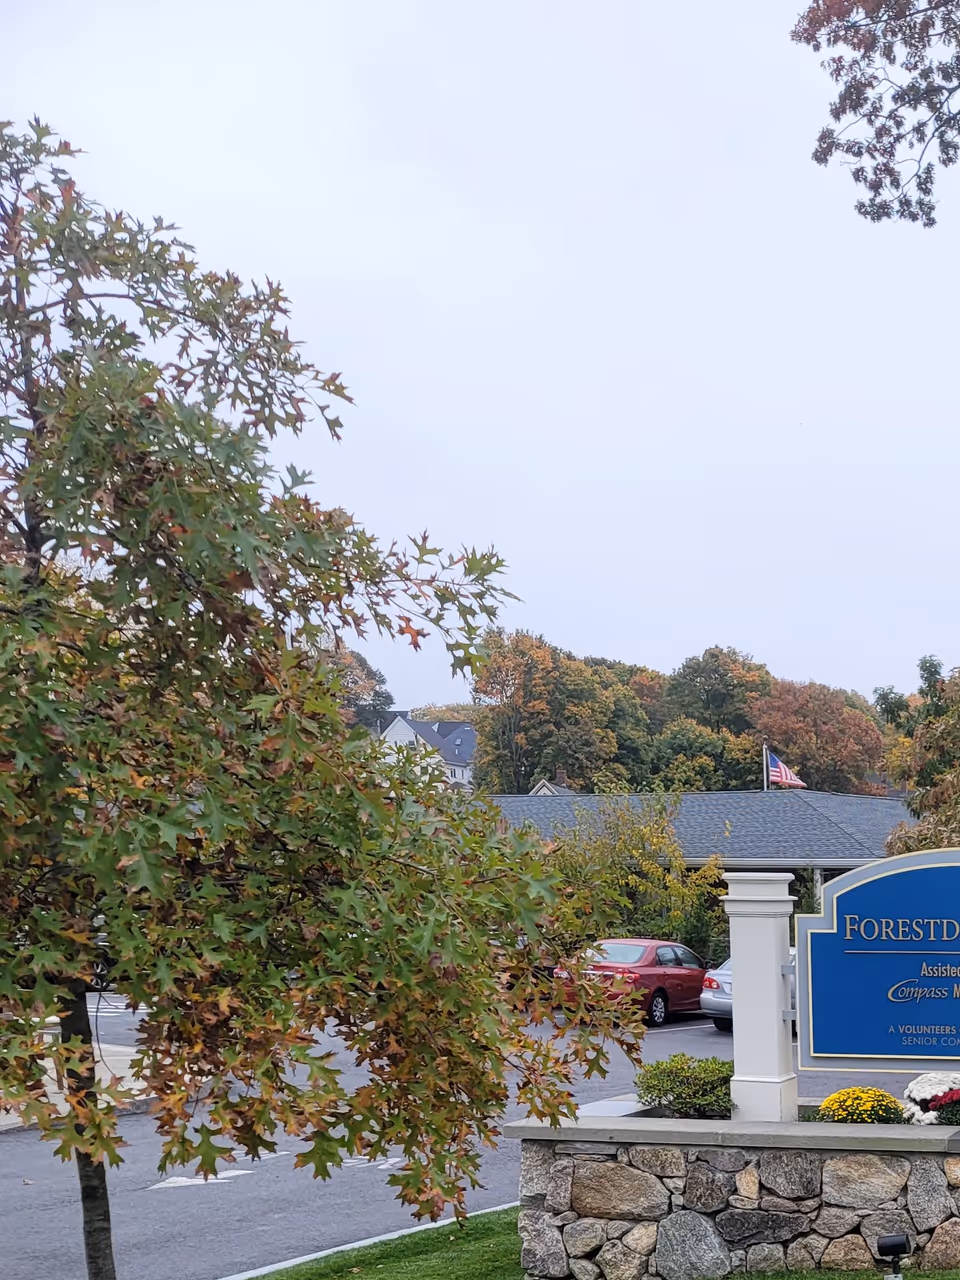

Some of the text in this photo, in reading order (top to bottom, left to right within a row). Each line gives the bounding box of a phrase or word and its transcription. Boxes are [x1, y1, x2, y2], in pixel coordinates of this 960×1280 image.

[888, 979, 948, 1003] Compass
[888, 1025, 895, 1035] A
[898, 1025, 956, 1035] VOLUNTEERS
[902, 1037, 937, 1046] SENIOR
